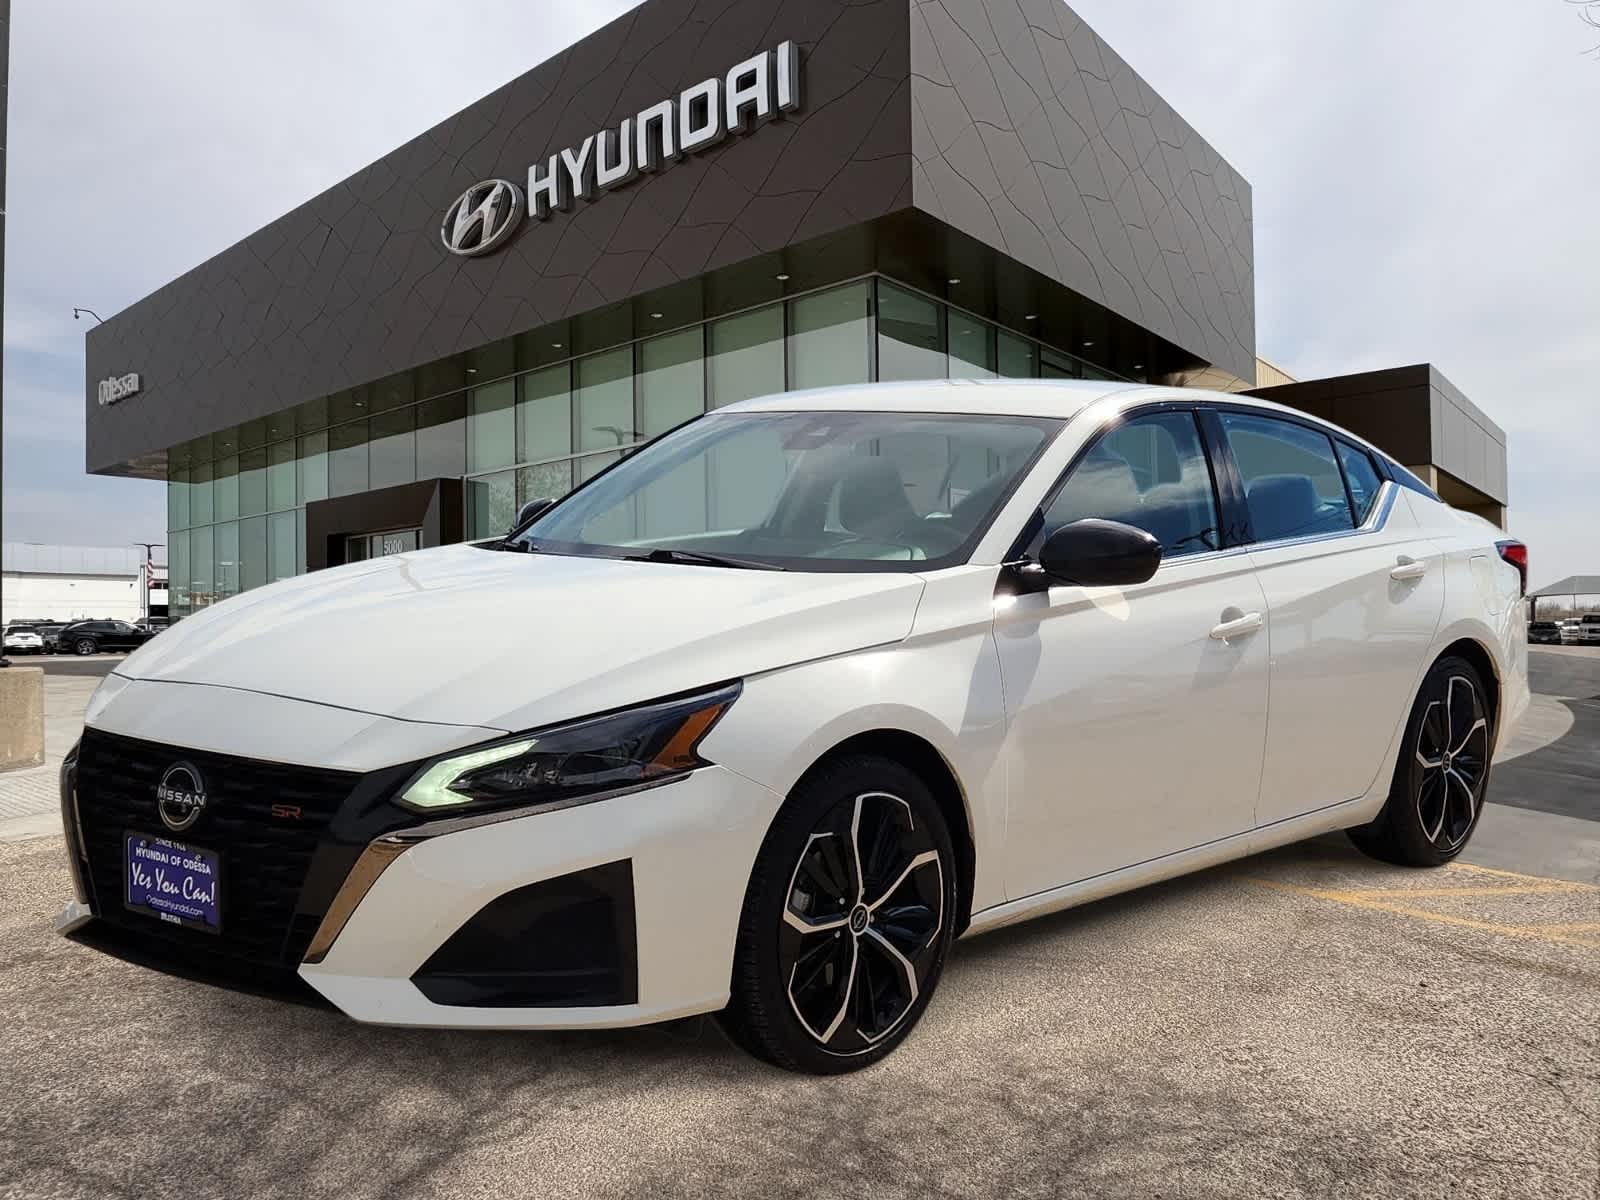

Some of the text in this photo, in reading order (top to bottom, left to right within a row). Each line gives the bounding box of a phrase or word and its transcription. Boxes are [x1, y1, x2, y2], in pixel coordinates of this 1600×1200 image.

[527, 40, 798, 220] HYUNDAI
[157, 786, 206, 807] NISSAN
[271, 804, 302, 819] SR
[136, 847, 212, 875] HYUNDAI OF ODESSA
[132, 862, 216, 906] Yes You Can!
